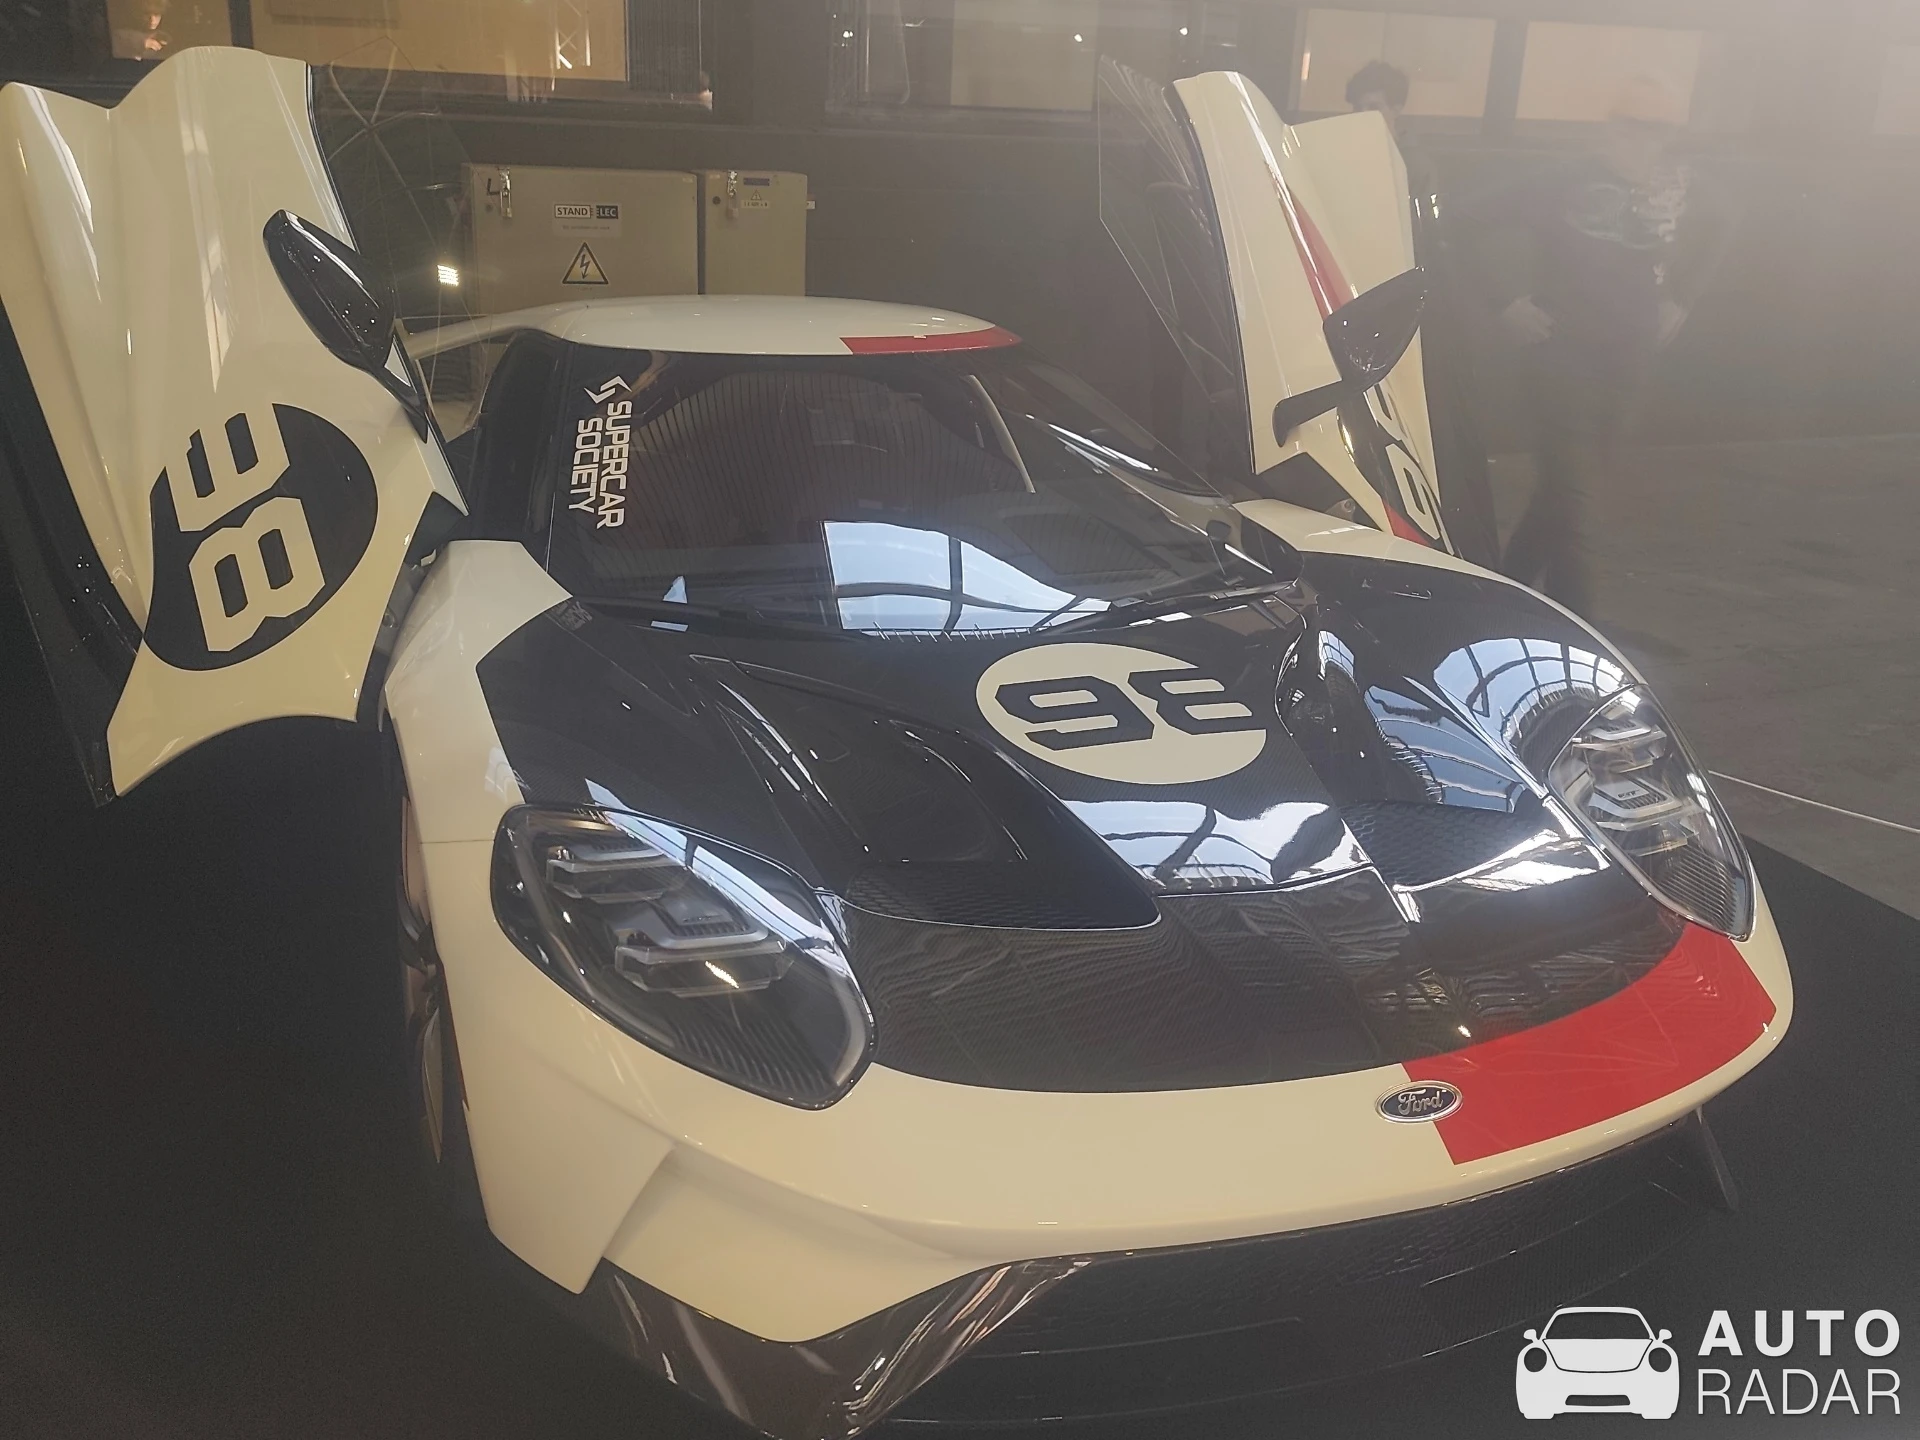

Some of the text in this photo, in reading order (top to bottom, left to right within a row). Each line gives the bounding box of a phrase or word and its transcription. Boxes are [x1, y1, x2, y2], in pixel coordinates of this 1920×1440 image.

[557, 207, 588, 216] STAND
[568, 417, 604, 513] SOCIETY
[596, 400, 633, 529] SUPERCAR
[995, 667, 1268, 751] 98
[1397, 1088, 1444, 1115] Ford
